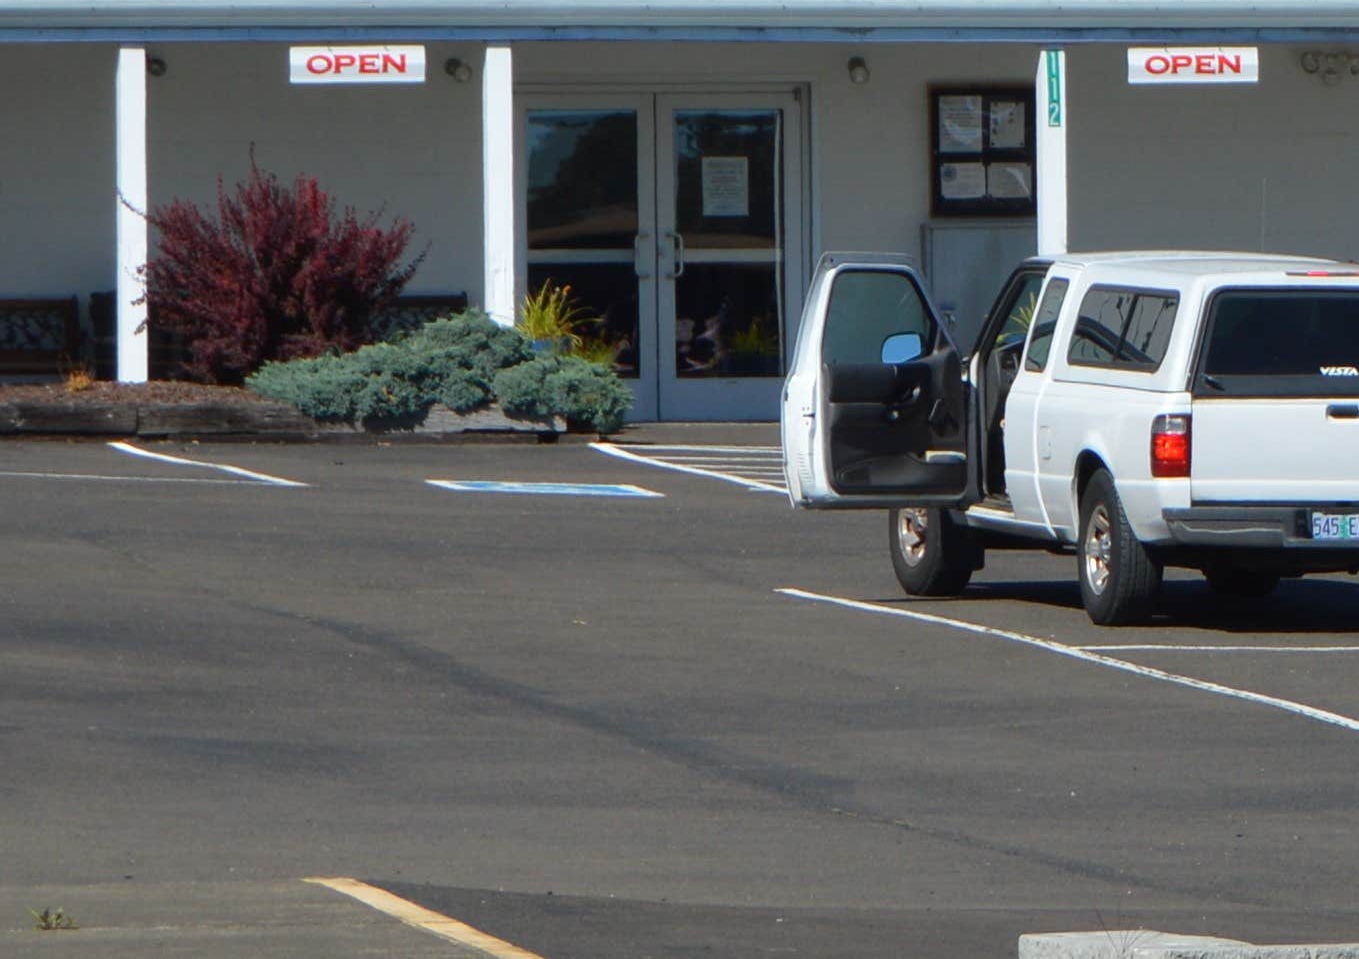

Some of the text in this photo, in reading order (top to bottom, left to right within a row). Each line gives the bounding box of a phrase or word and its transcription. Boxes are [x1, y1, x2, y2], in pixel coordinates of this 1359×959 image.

[306, 54, 406, 74] OPEN
[1145, 55, 1241, 74] OPEN
[1049, 51, 1060, 125] 112
[1319, 366, 1359, 376] VISTA
[1313, 517, 1340, 536] 545
